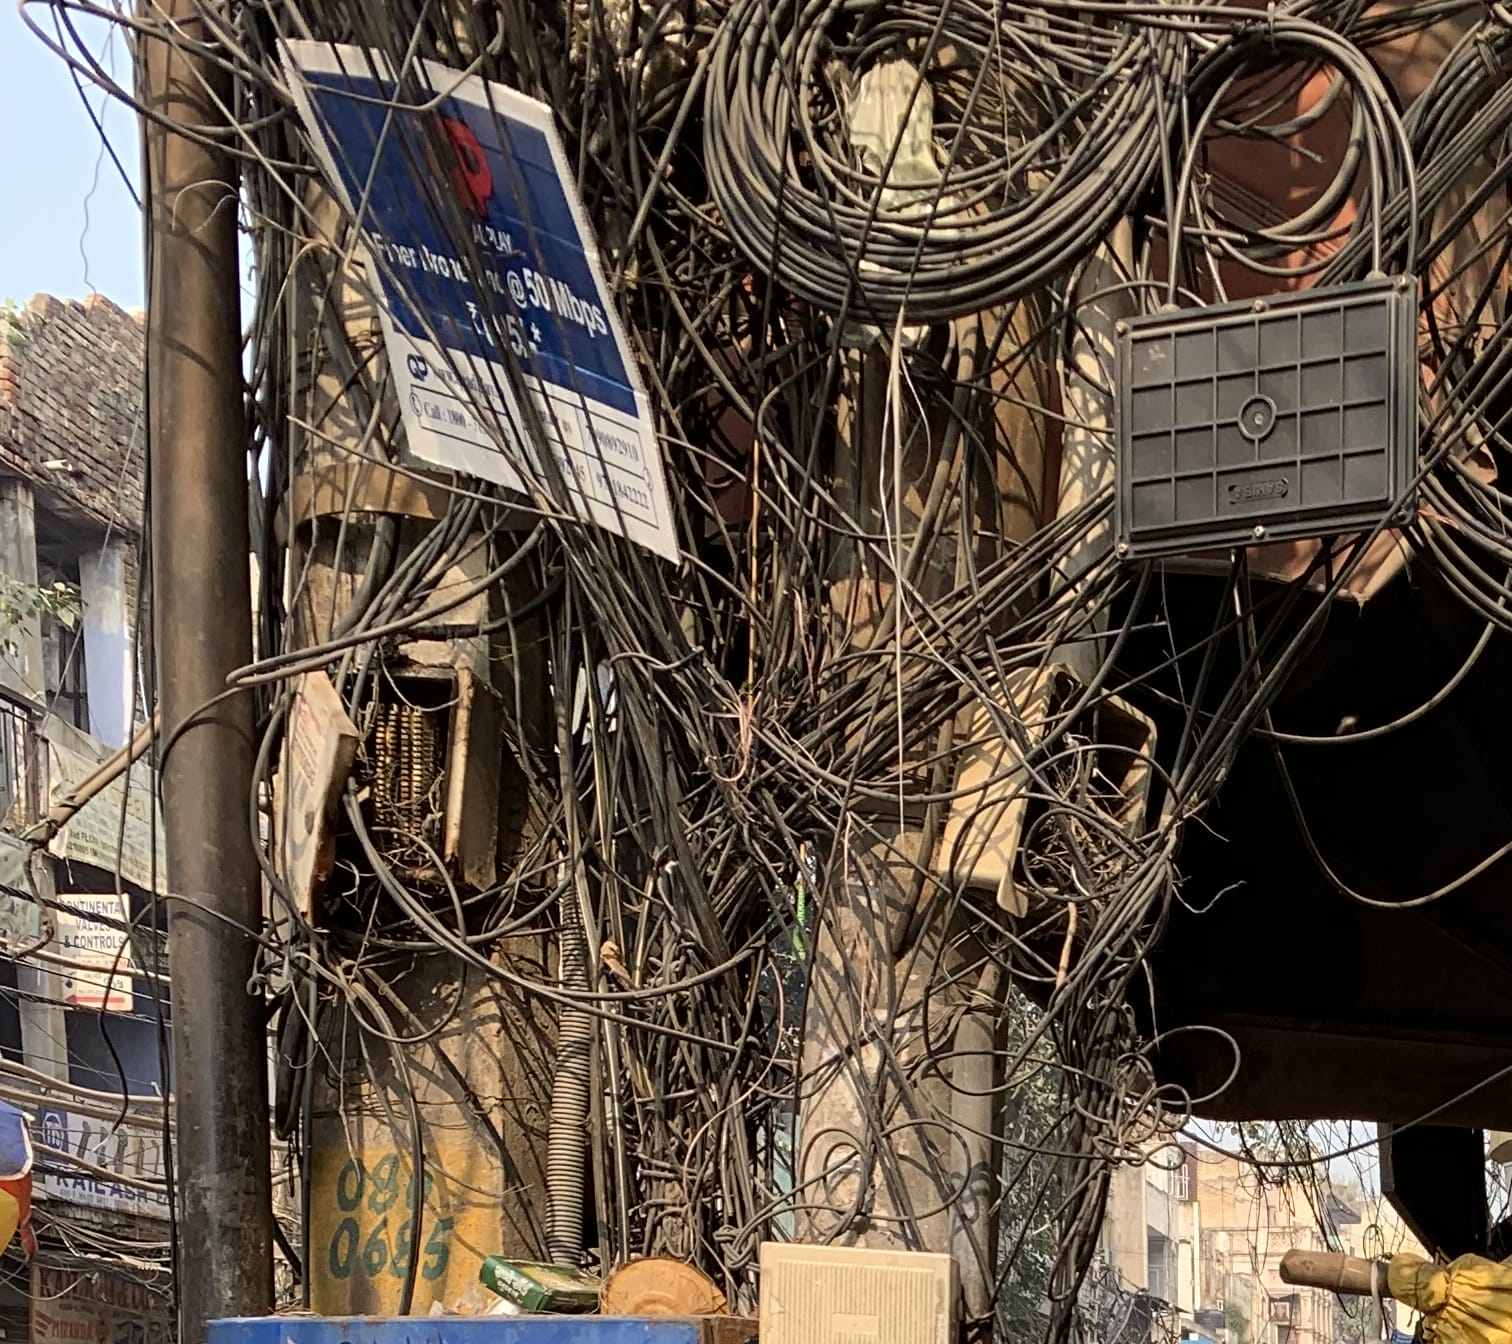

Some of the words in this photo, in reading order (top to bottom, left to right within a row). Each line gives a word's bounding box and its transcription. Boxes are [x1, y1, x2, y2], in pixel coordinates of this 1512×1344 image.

[506, 269, 528, 309] @
[523, 267, 551, 312] 50
[550, 278, 608, 338] Mbps
[59, 896, 125, 921] ONTINENTA
[64, 934, 72, 948] &
[73, 935, 125, 950] CONTROLS
